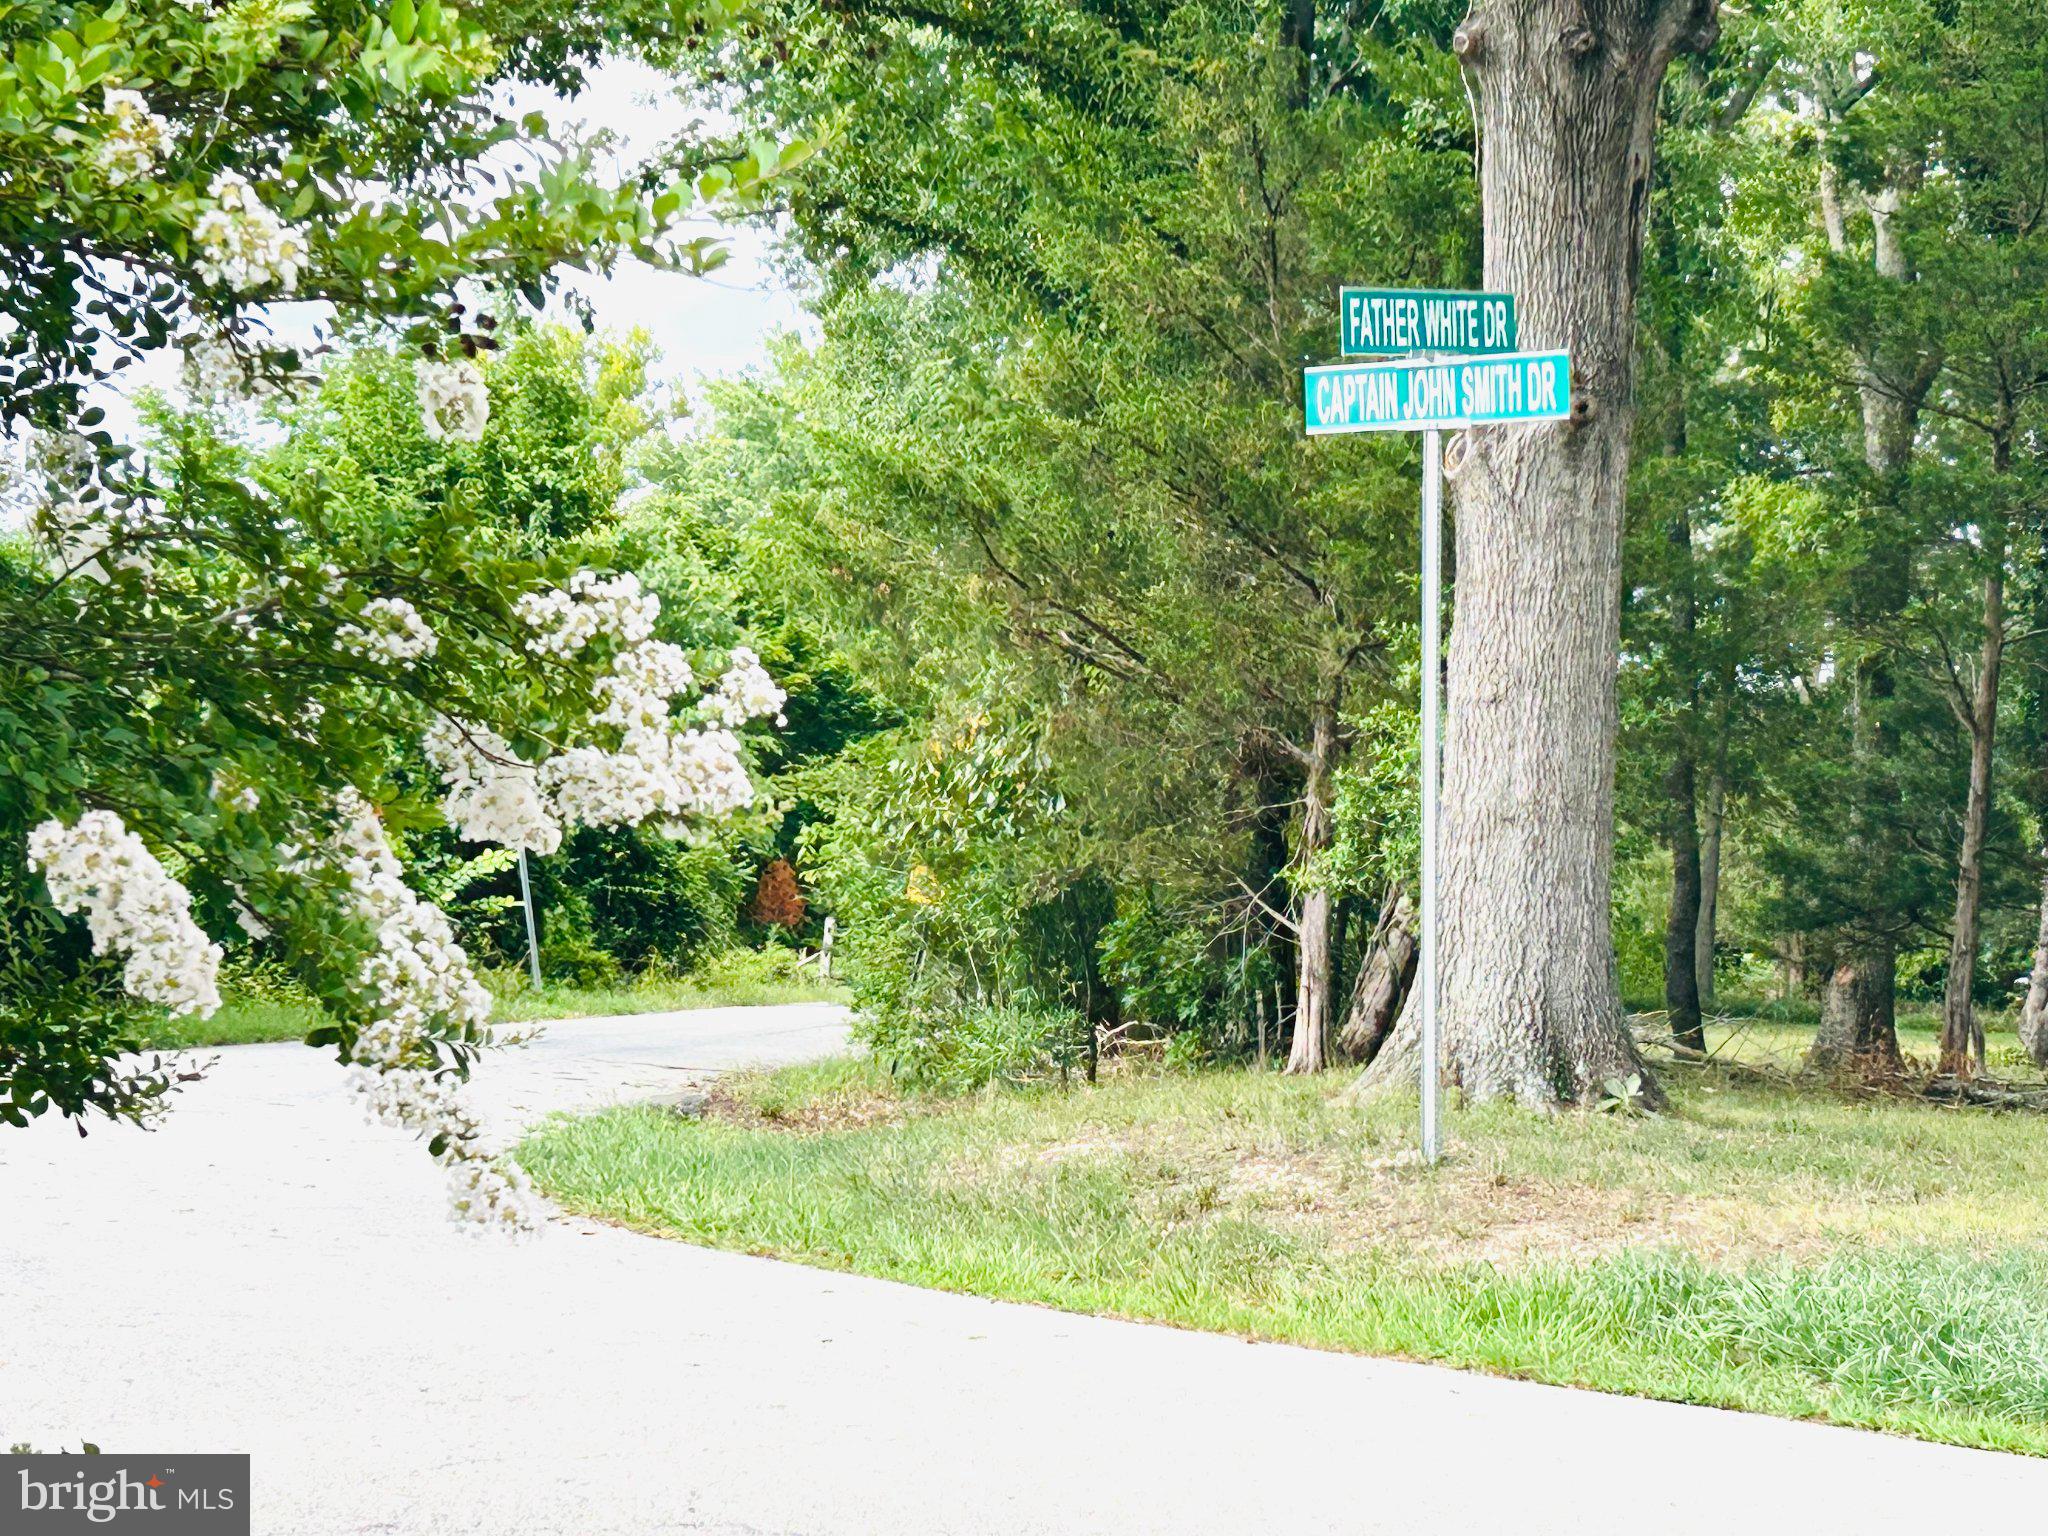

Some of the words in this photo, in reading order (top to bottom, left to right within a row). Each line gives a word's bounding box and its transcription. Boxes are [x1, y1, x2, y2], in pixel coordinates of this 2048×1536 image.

[1350, 298, 1420, 347] FATHER
[1423, 299, 1479, 347] WHITE
[1484, 301, 1508, 347] DR
[1317, 372, 1398, 424] CAPTAIN
[1403, 367, 1457, 420] JOHN
[1461, 363, 1522, 416] SMITH
[1527, 361, 1557, 412] DR
